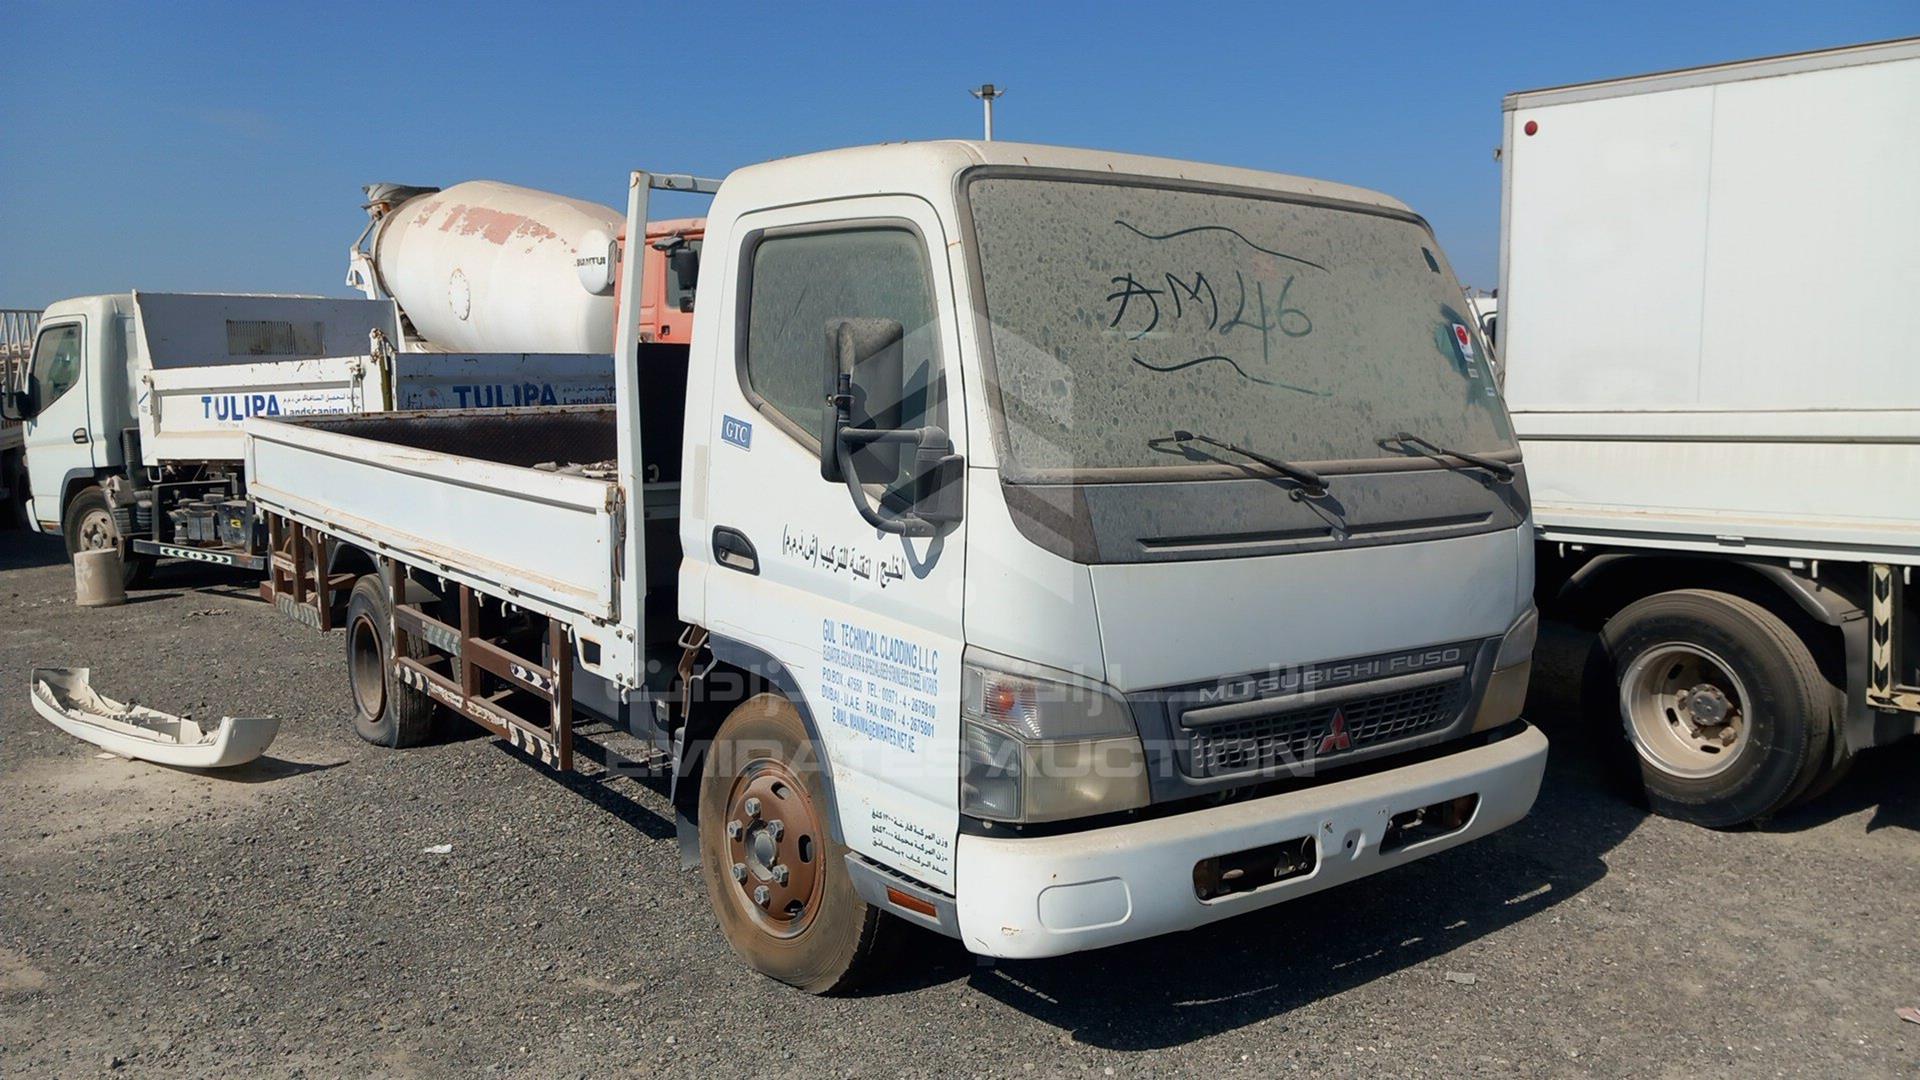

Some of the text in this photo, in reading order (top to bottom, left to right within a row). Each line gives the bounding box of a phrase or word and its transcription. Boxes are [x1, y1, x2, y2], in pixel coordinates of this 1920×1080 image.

[201, 394, 281, 421] TULIPA
[453, 383, 558, 408] TULIPA
[726, 421, 748, 443] GTC
[841, 623, 878, 657] TECHNICAL
[880, 634, 917, 669] CLADDING
[1199, 648, 1460, 701] MITSUBISHI FUSO
